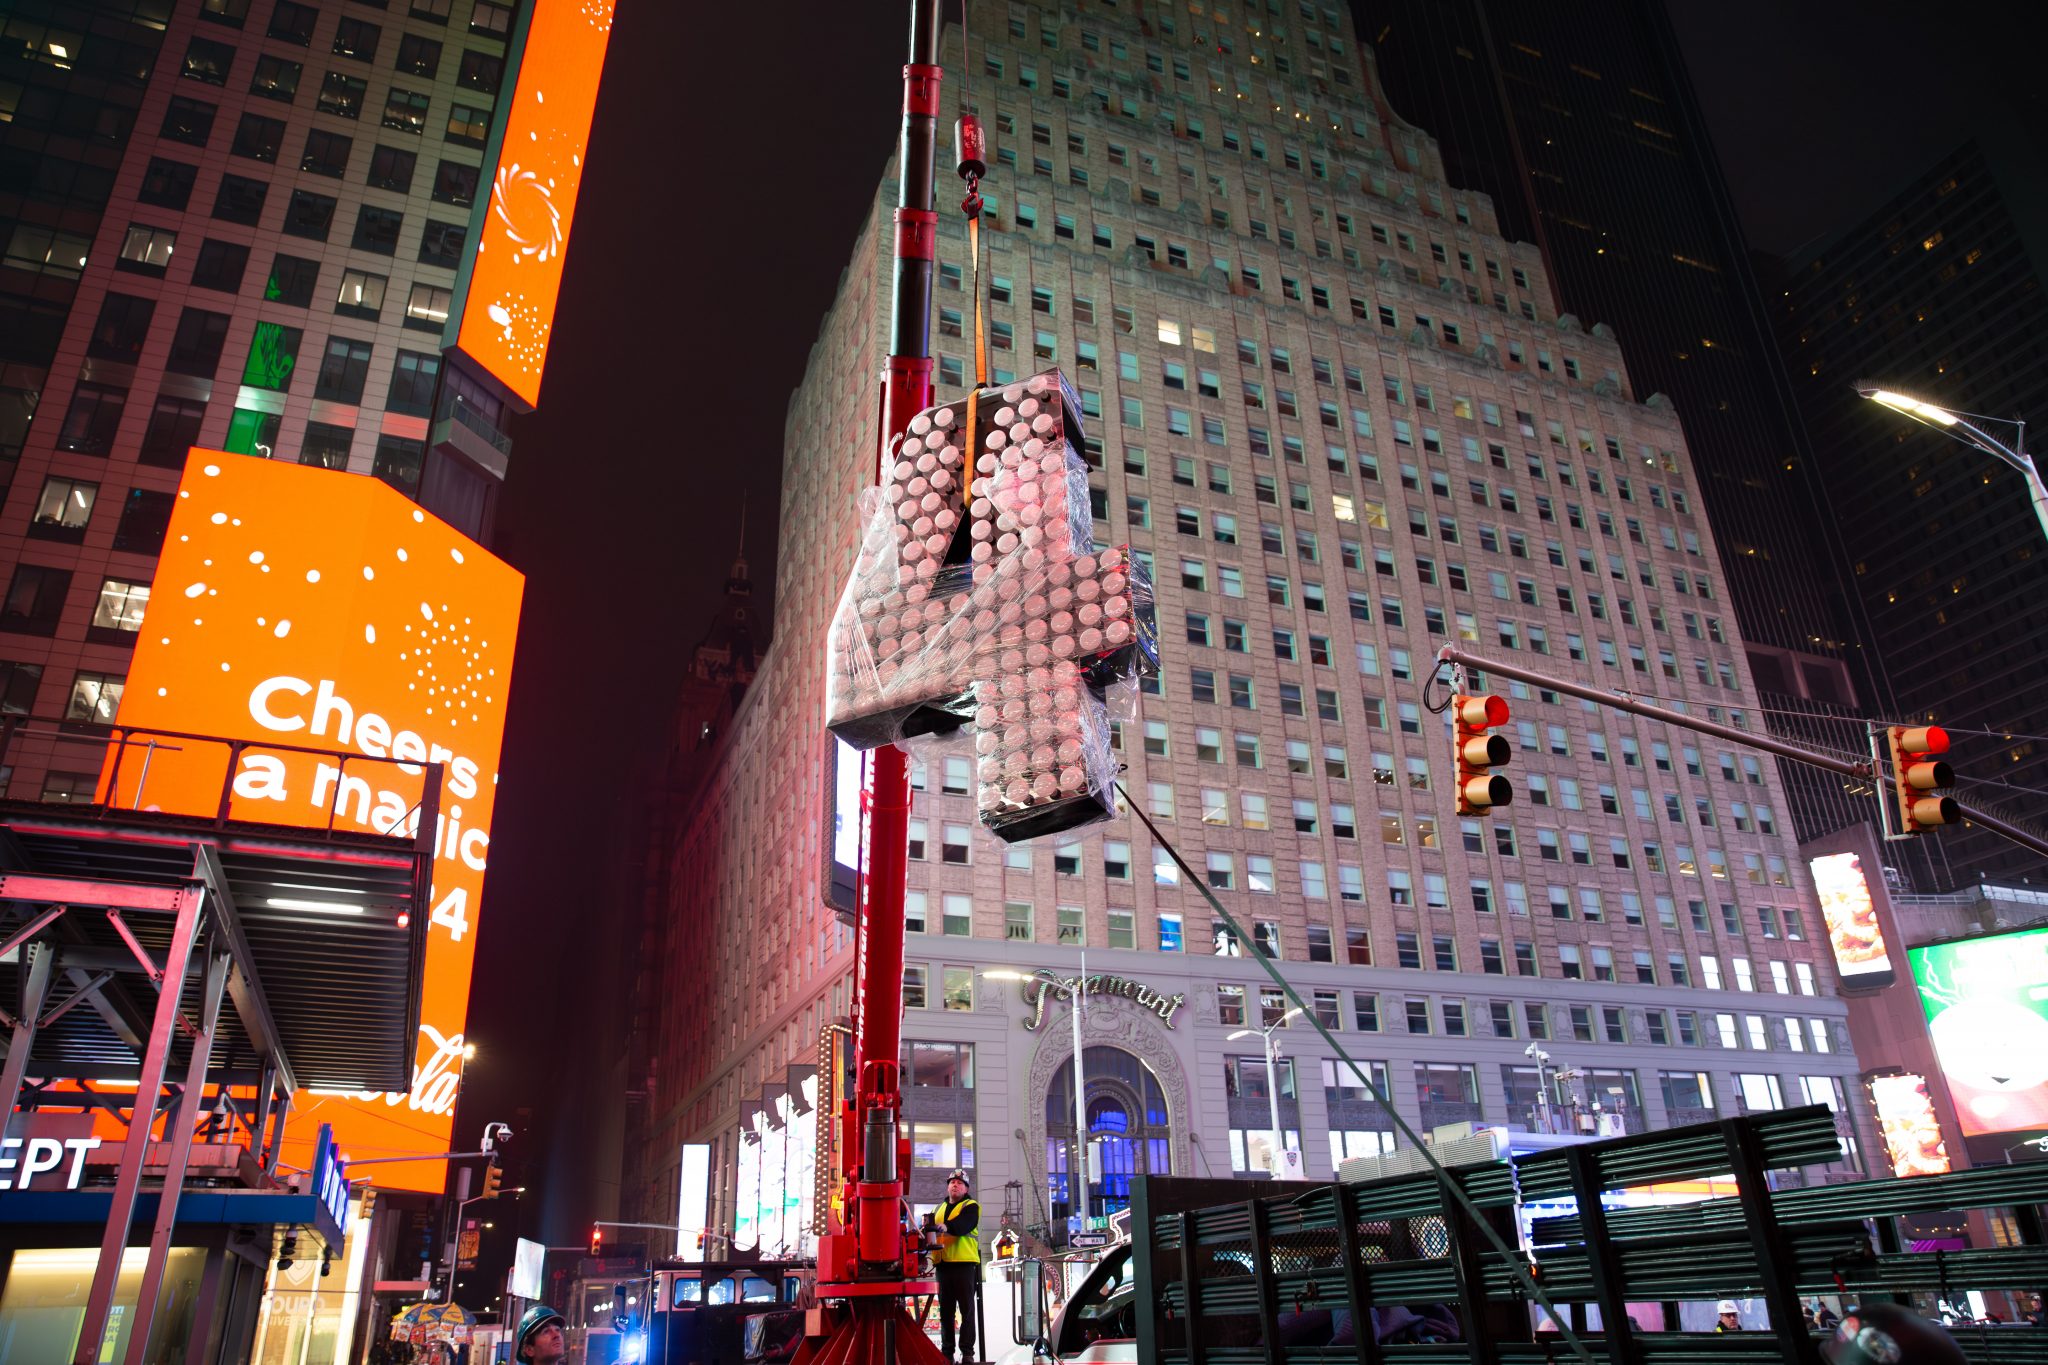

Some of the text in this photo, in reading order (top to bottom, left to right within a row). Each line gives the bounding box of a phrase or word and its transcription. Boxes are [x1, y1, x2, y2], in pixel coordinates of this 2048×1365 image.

[248, 675, 479, 799] Cheers
[233, 755, 287, 801] a
[1023, 969, 1185, 1030] Paramount
